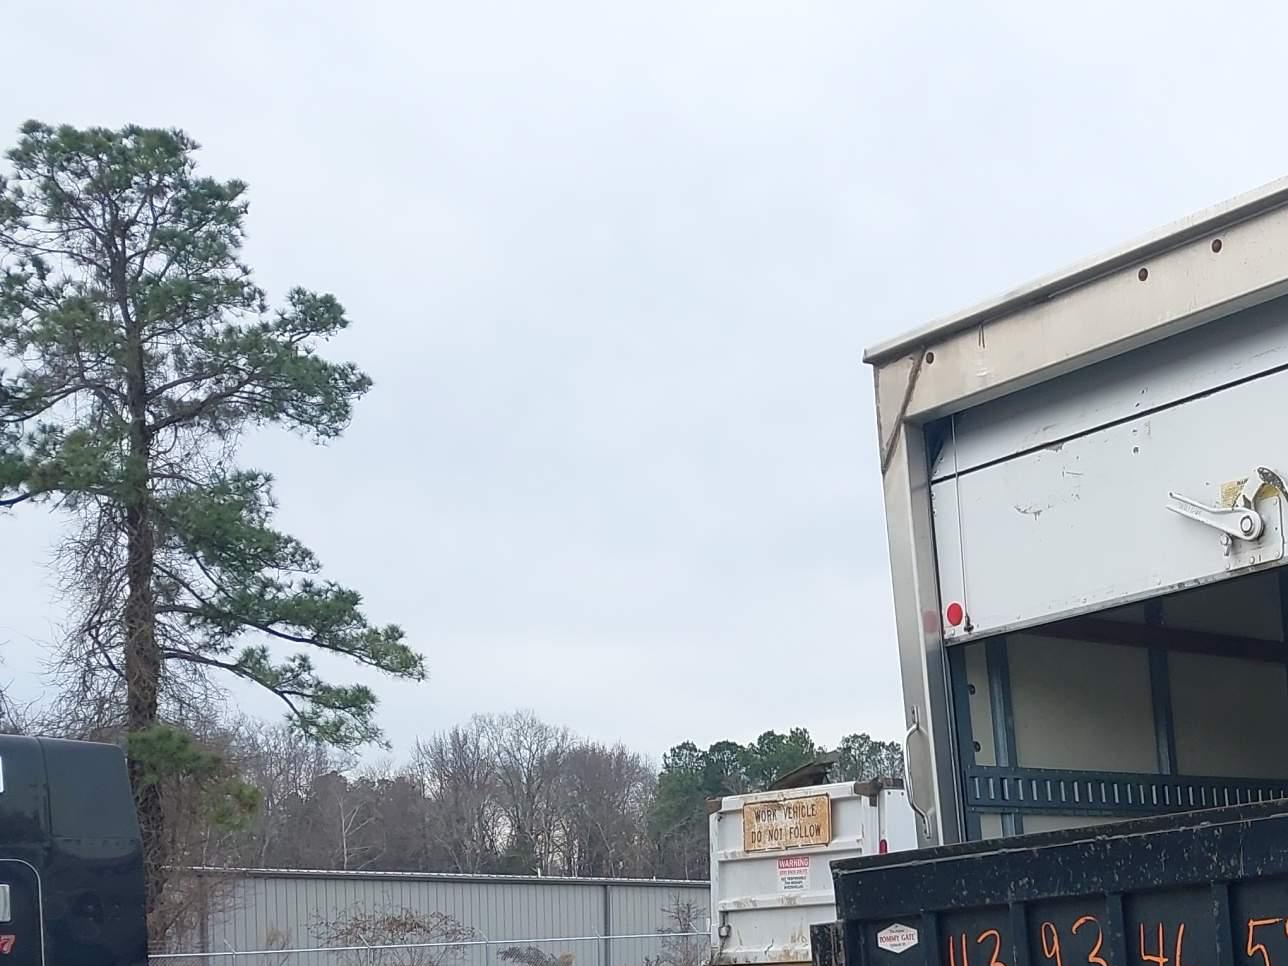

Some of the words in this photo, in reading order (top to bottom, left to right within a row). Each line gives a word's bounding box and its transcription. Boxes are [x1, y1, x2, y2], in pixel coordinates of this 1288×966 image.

[754, 807, 777, 823] WORK
[783, 804, 817, 820] VEHICLE
[751, 830, 762, 843] DO
[768, 828, 783, 841] NOT
[789, 824, 821, 839] FOLLOW
